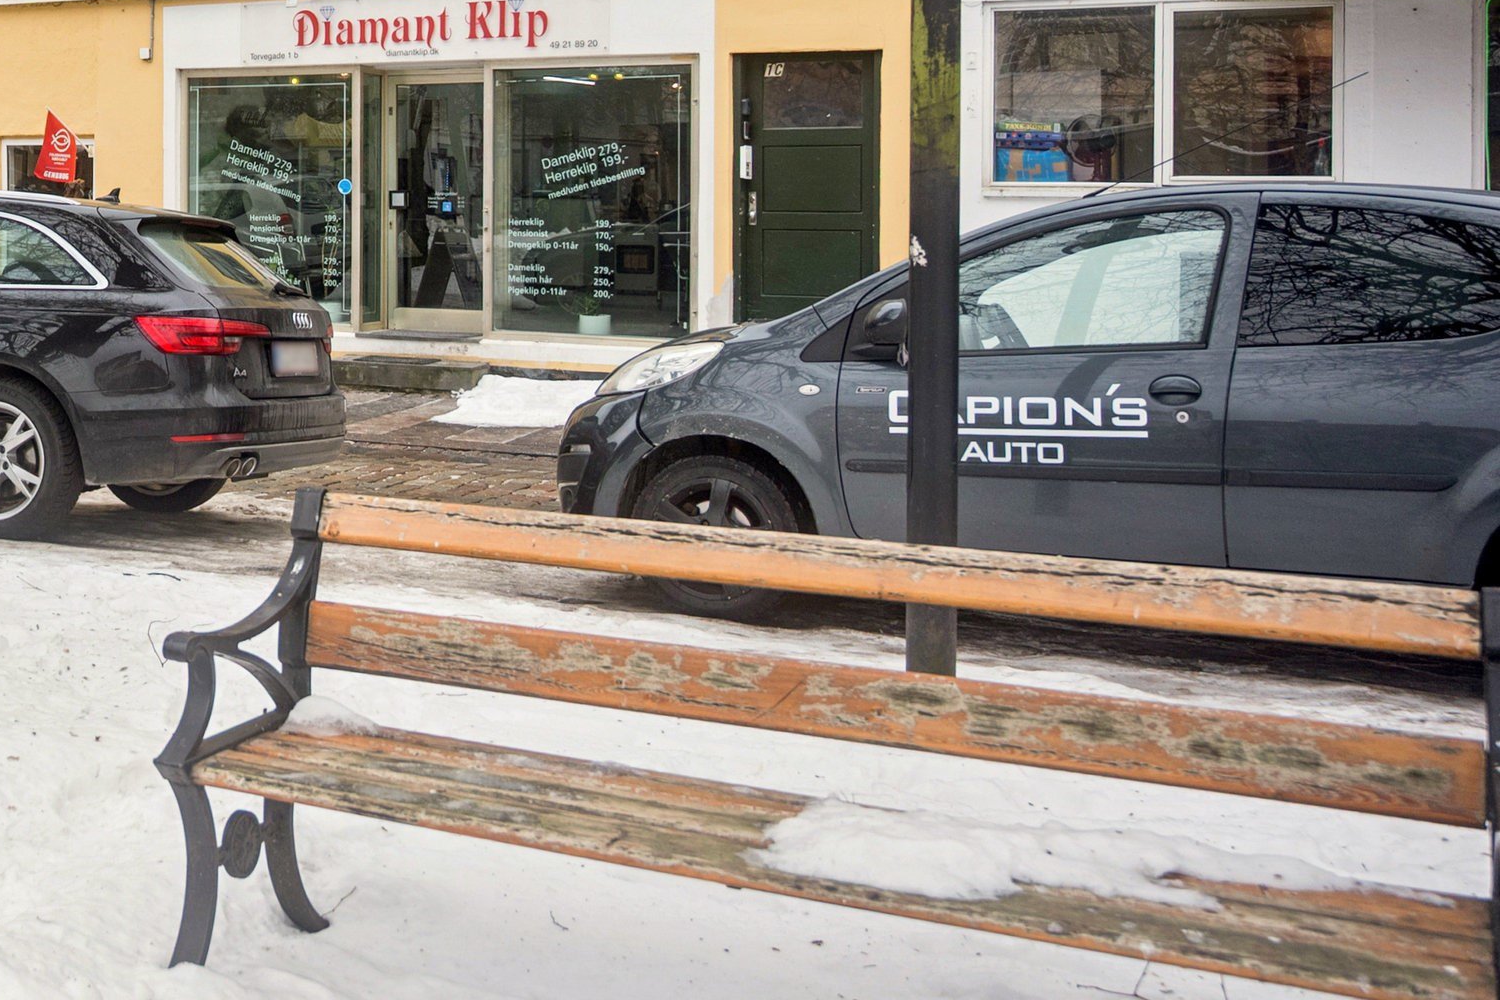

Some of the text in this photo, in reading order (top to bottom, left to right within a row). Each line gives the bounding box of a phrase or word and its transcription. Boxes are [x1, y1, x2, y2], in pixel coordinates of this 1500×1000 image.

[293, 0, 549, 50] Diamant Klip
[549, 39, 598, 49] 49 21 89 20
[250, 52, 286, 61] Torvegade
[385, 47, 440, 58] diamantklip.dk
[230, 139, 275, 164] Dameklip
[541, 146, 596, 170] Dameklip
[226, 152, 270, 177] Herreklip
[544, 162, 598, 184] Herreklip
[221, 169, 302, 203] med/uden tidsbestilling
[547, 166, 646, 200] med/uden tidsbestilling
[249, 214, 281, 222] Herreklip
[508, 218, 545, 227] Herreklip
[508, 229, 548, 237] Pensionist
[508, 241, 552, 250] Drengeklip
[507, 263, 546, 273] Dameklip
[507, 275, 538, 284] Mellem
[539, 275, 553, 284] hår
[507, 286, 540, 296] Pigeklip
[233, 367, 247, 377] A4
[960, 441, 1064, 464] AUTO
